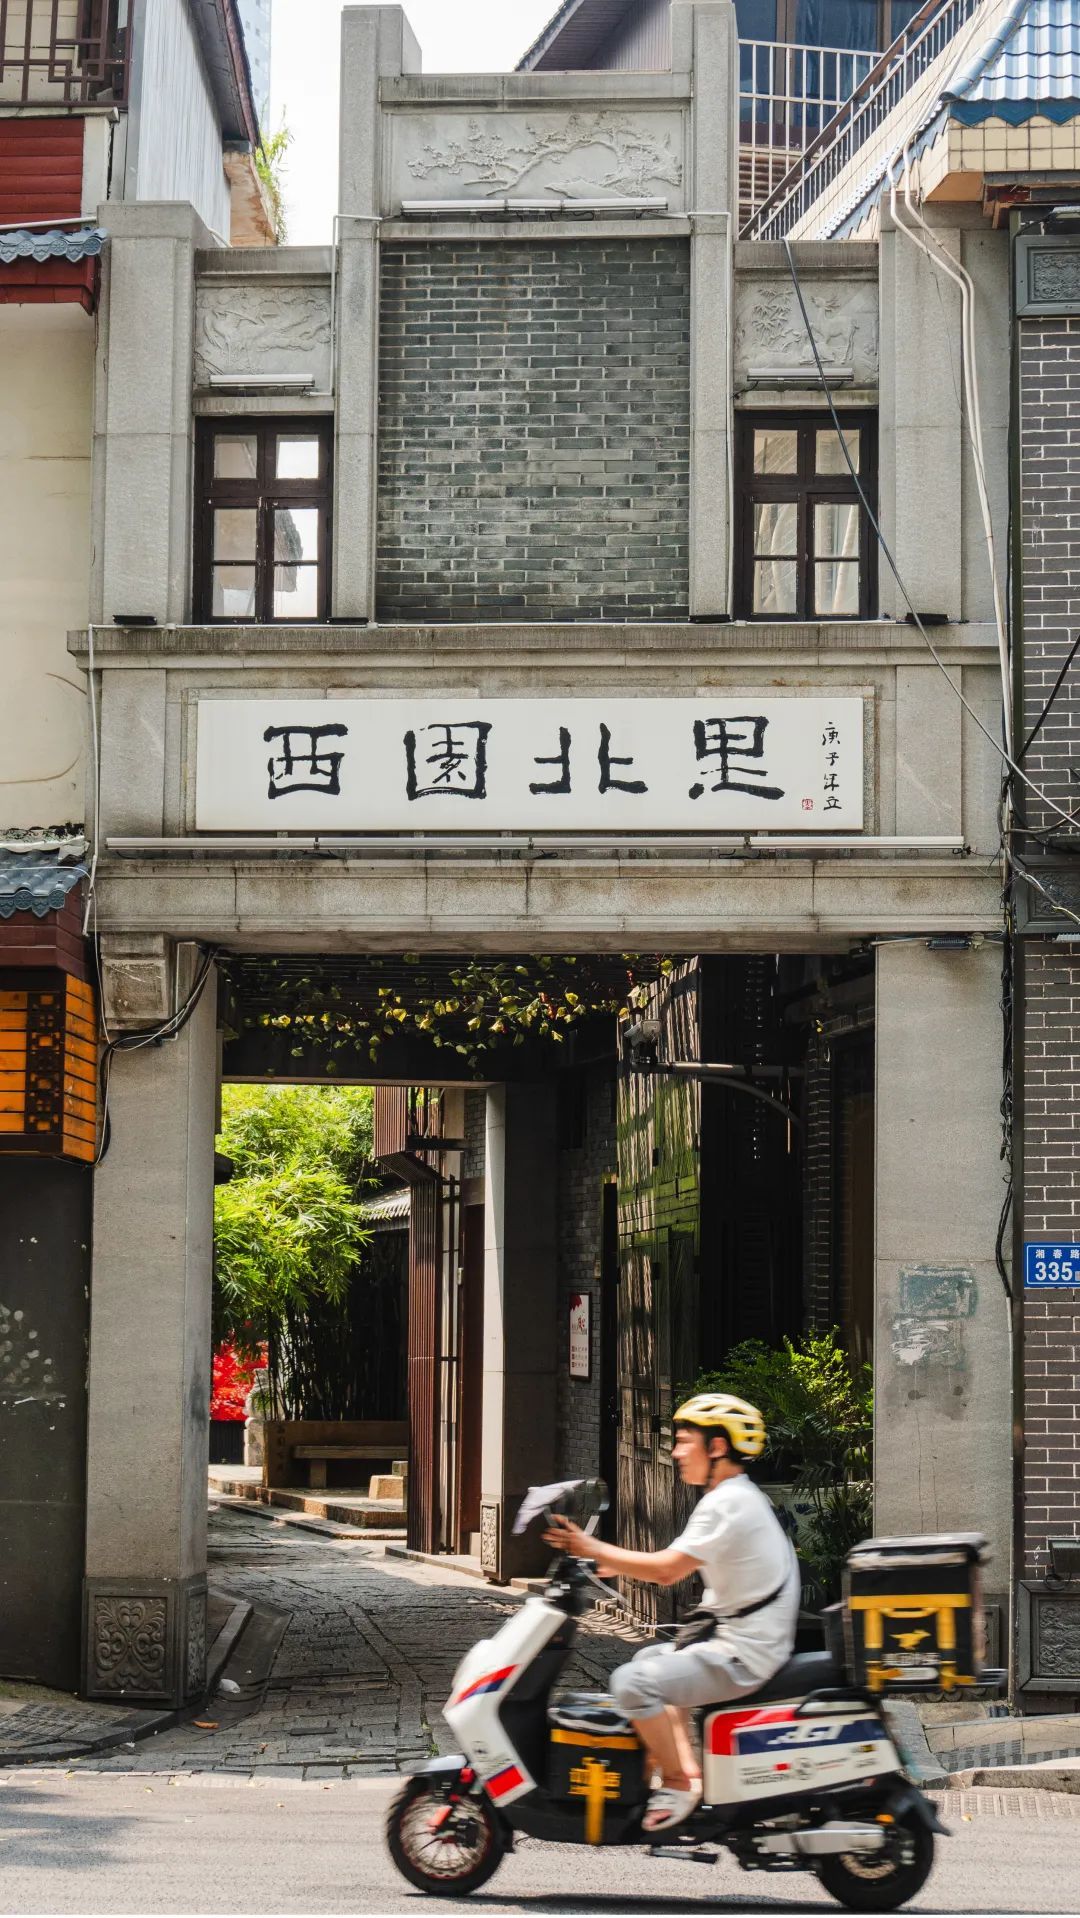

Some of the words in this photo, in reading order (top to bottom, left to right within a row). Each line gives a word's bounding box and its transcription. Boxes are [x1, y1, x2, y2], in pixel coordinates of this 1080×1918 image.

[822, 721, 842, 811] 庚子年立
[1035, 1248, 1080, 1259] 湘春路
[1035, 1261, 1073, 1281] 335
